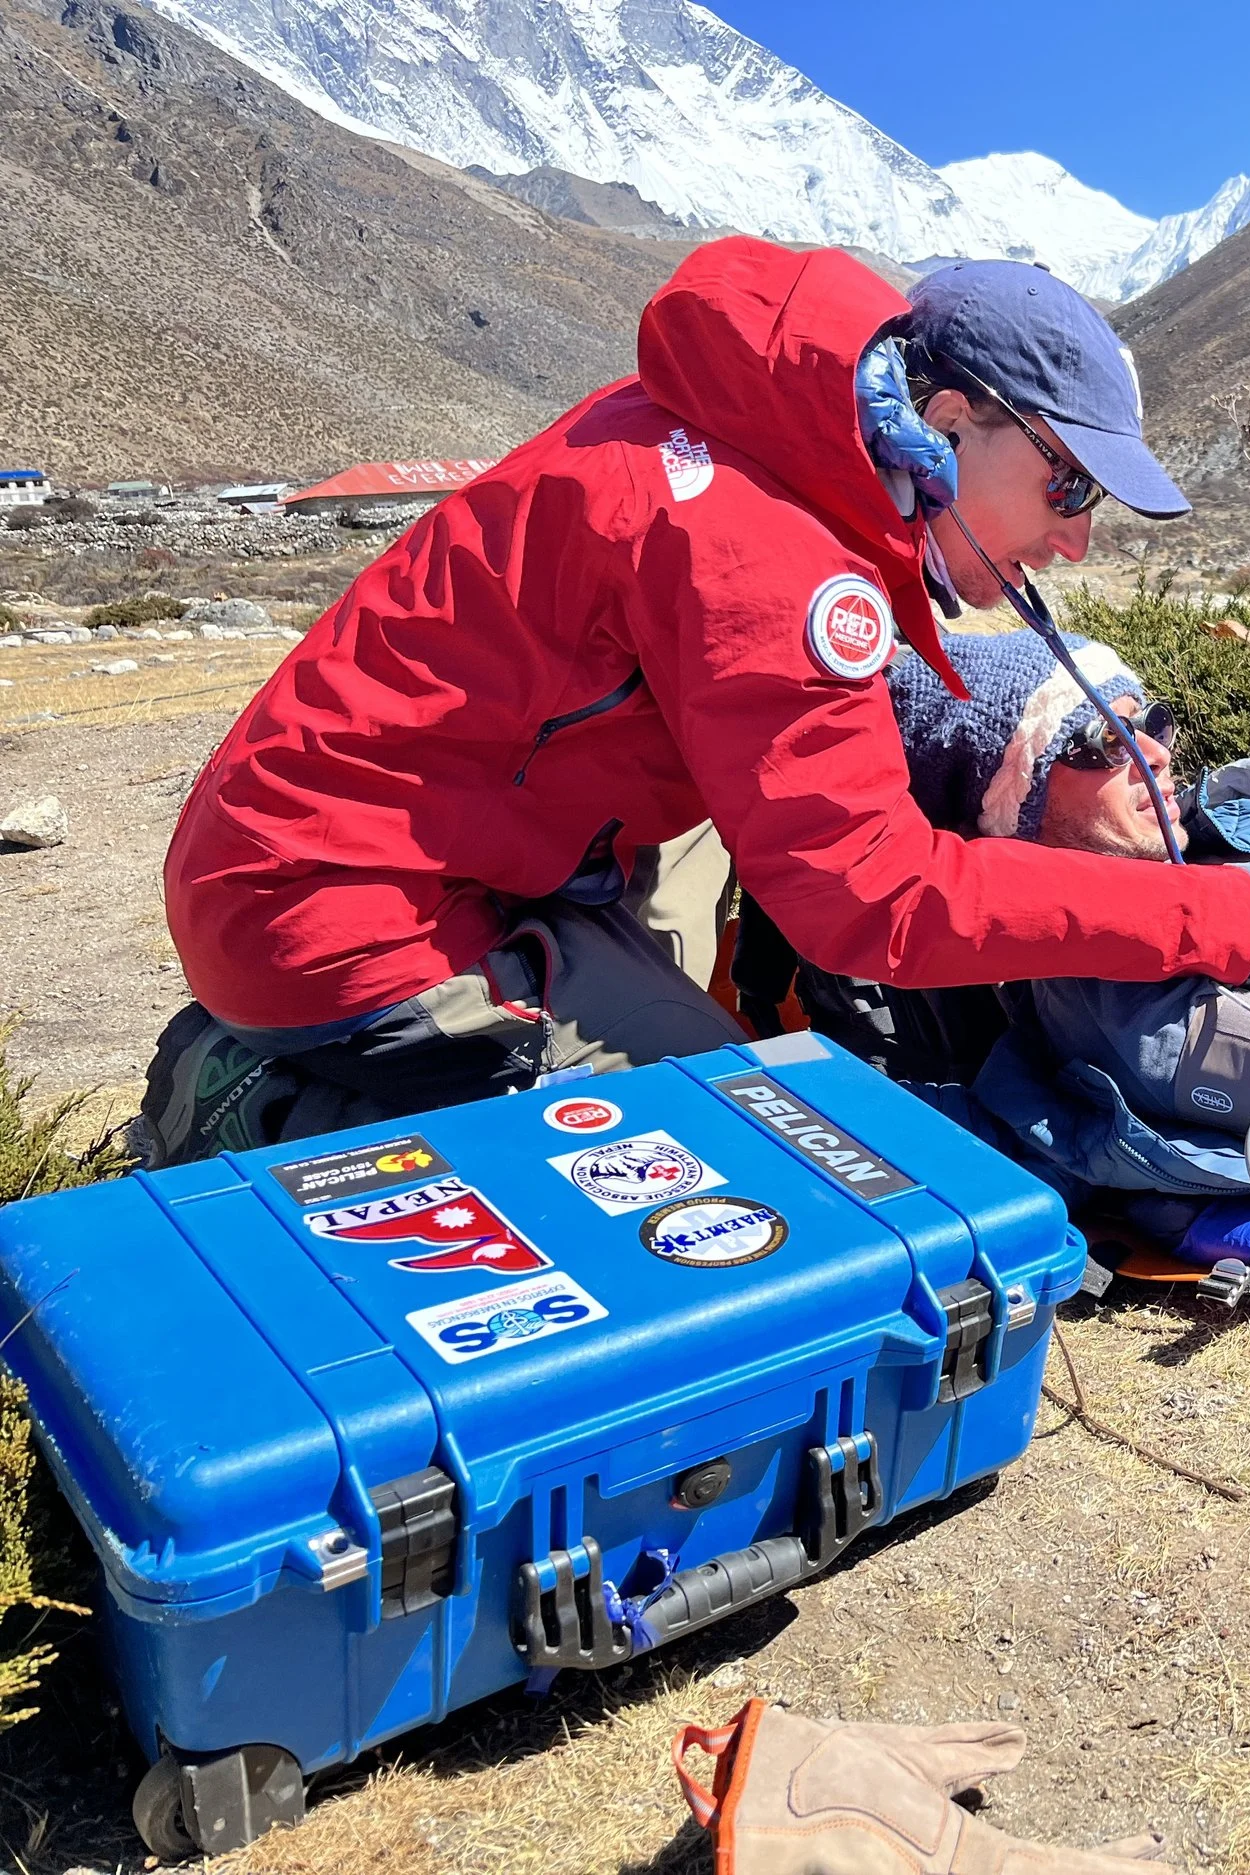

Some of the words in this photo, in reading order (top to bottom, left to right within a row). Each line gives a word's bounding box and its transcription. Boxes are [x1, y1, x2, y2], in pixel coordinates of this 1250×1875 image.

[669, 428, 699, 470] NORTH
[690, 441, 711, 466] THE
[1024, 427, 1053, 458] NATIVE
[659, 441, 681, 474] FACE
[831, 606, 877, 641] RED
[834, 632, 869, 650] MEDICINE
[1197, 1092, 1226, 1109] LATEX
[562, 1107, 609, 1125] RED
[730, 1085, 888, 1182] PELICAN
[588, 1142, 633, 1159] NEPAL
[655, 1144, 698, 1181] HIMALAYAN
[300, 1167, 378, 1192] PELICAN
[302, 1169, 337, 1182] CASE
[576, 1165, 639, 1201] ASSOCIATION
[310, 1179, 469, 1228] NEPAL
[644, 1180, 693, 1201] RESCUE
[686, 1197, 727, 1206] PROUD
[692, 1209, 776, 1242] NAEMT
[498, 1298, 513, 1309] EN
[516, 1283, 566, 1303] EXPERTOS
[427, 1302, 497, 1329] EMERGENCIAS
[438, 1294, 590, 1353] SOS
